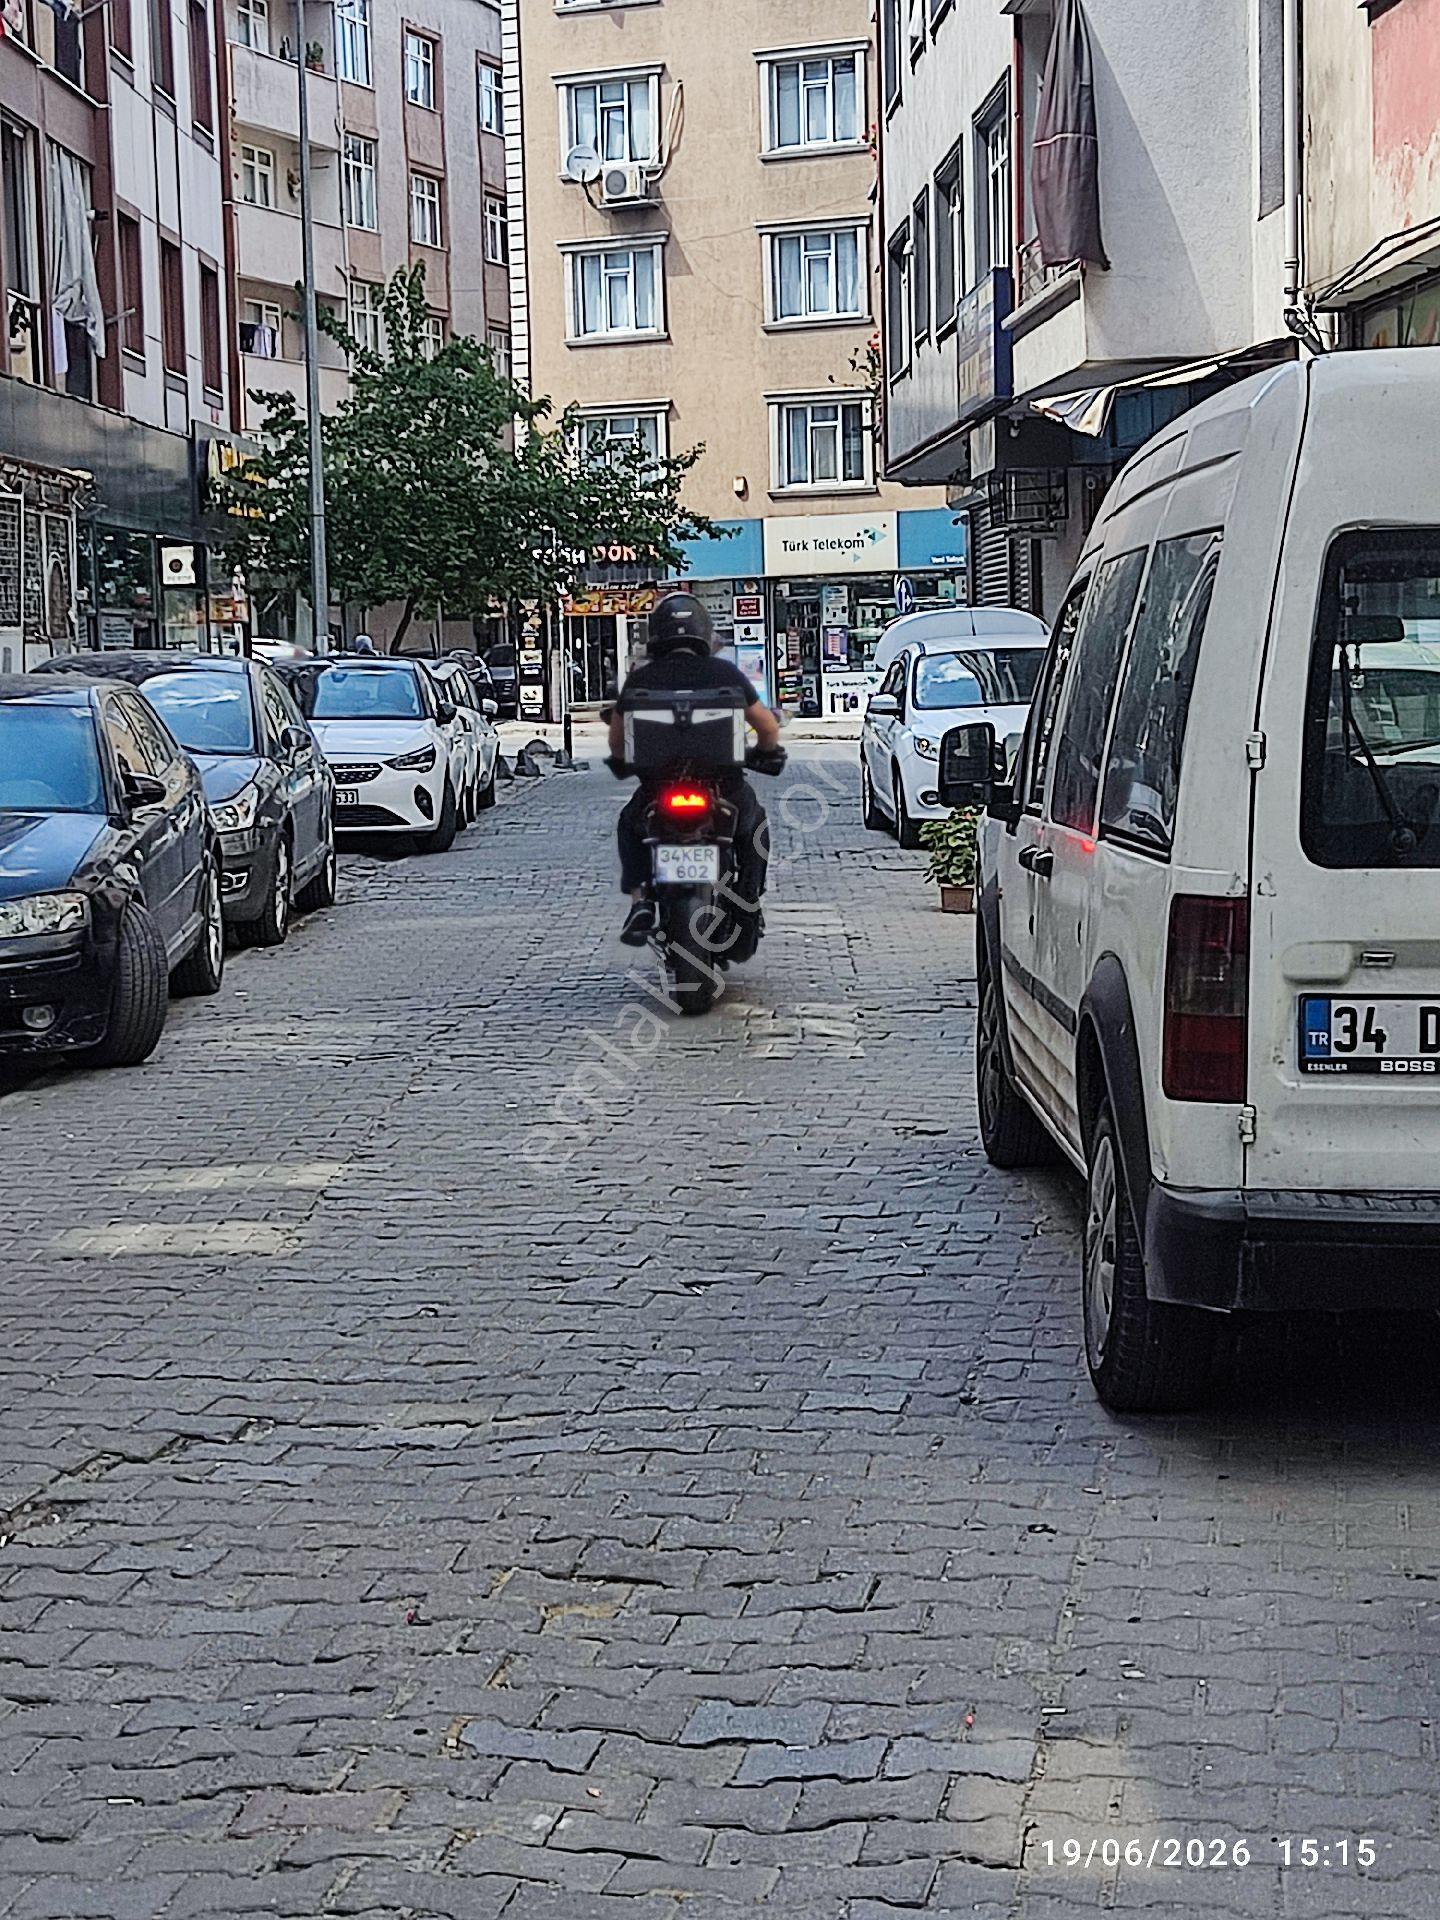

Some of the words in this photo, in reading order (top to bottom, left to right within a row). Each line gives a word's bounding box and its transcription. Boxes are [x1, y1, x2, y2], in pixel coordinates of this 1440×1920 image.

[782, 539, 809, 552] Türk
[813, 537, 865, 551] Telekom
[676, 865, 709, 879] 602
[1333, 1006, 1387, 1054] 34
[1308, 1032, 1329, 1046] TR
[1307, 1063, 1348, 1072] ESENLER
[1380, 1060, 1436, 1072] BOSS
